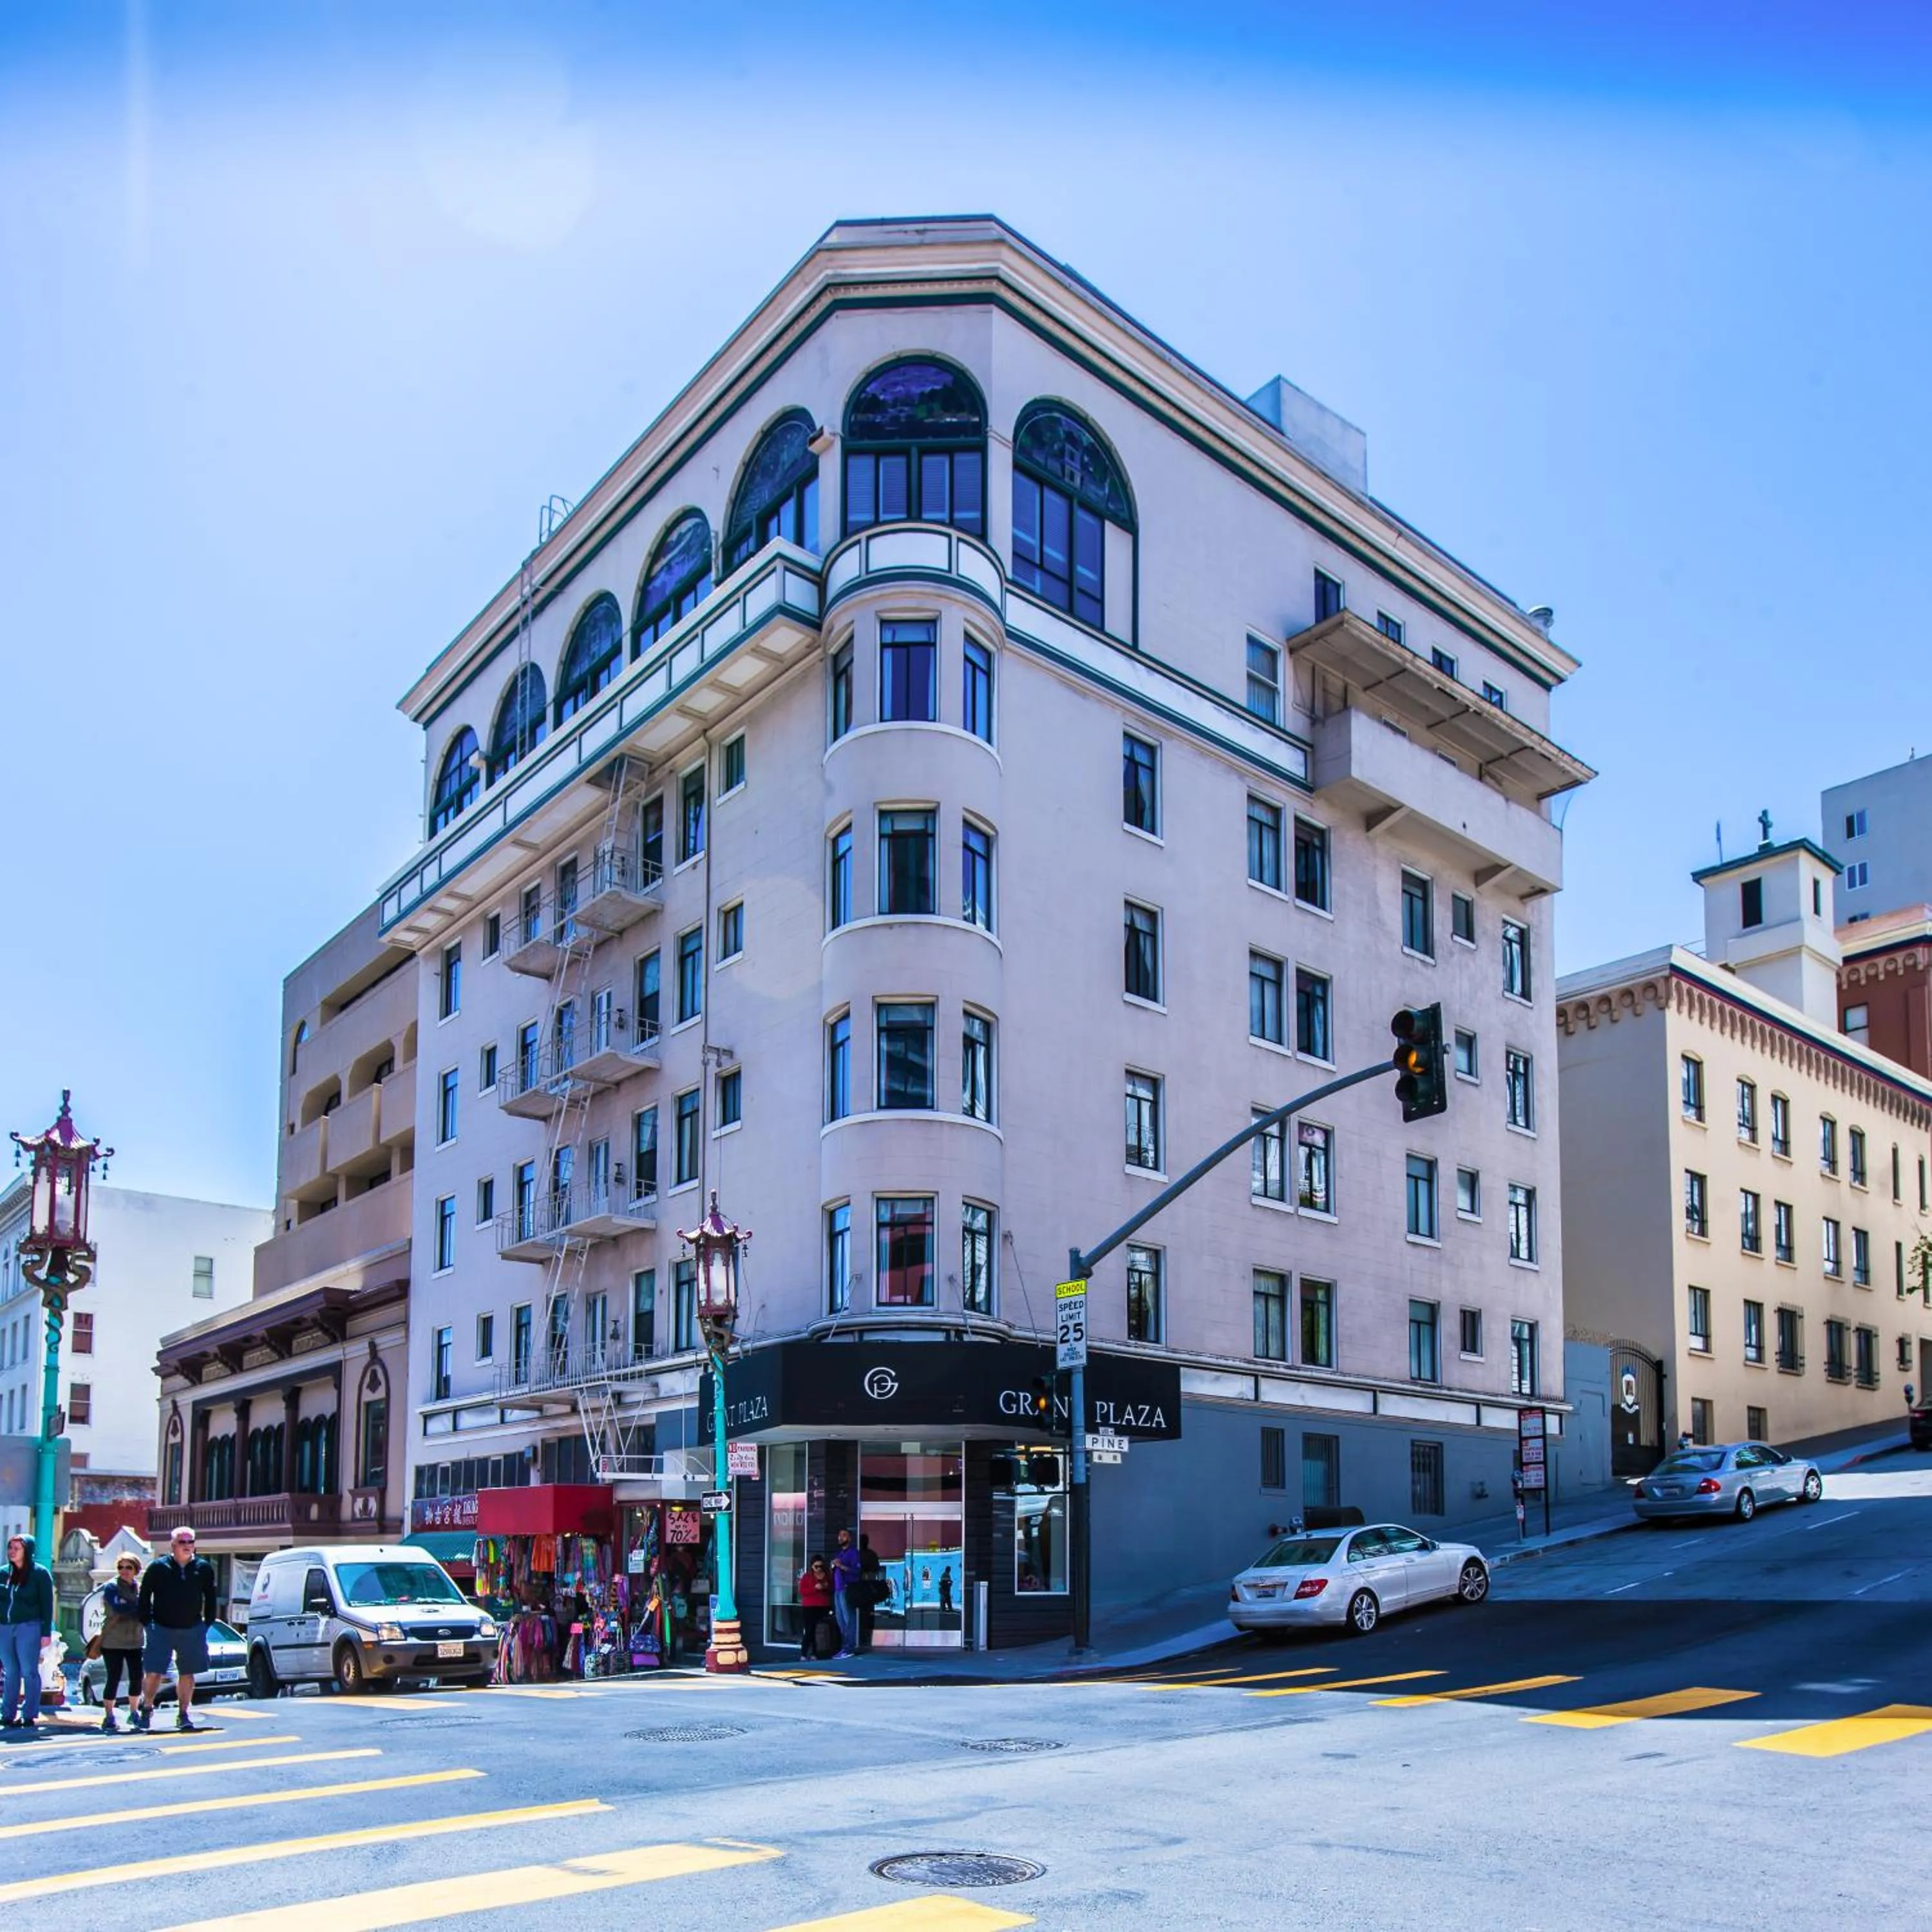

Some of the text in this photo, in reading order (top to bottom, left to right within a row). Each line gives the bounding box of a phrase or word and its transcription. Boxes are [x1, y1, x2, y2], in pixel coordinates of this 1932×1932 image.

[1057, 1282, 1085, 1296] SCHOOL
[1058, 1300, 1084, 1312] SPEED
[1061, 1311, 1081, 1322] LIMIT
[1059, 1322, 1084, 1345] 25
[738, 1395, 768, 1424] PLAZA
[999, 1390, 1168, 1428] GRN PLAZA
[1092, 1437, 1124, 1449] PINE
[668, 1513, 697, 1524] SALE
[670, 1529, 692, 1544] 70%
